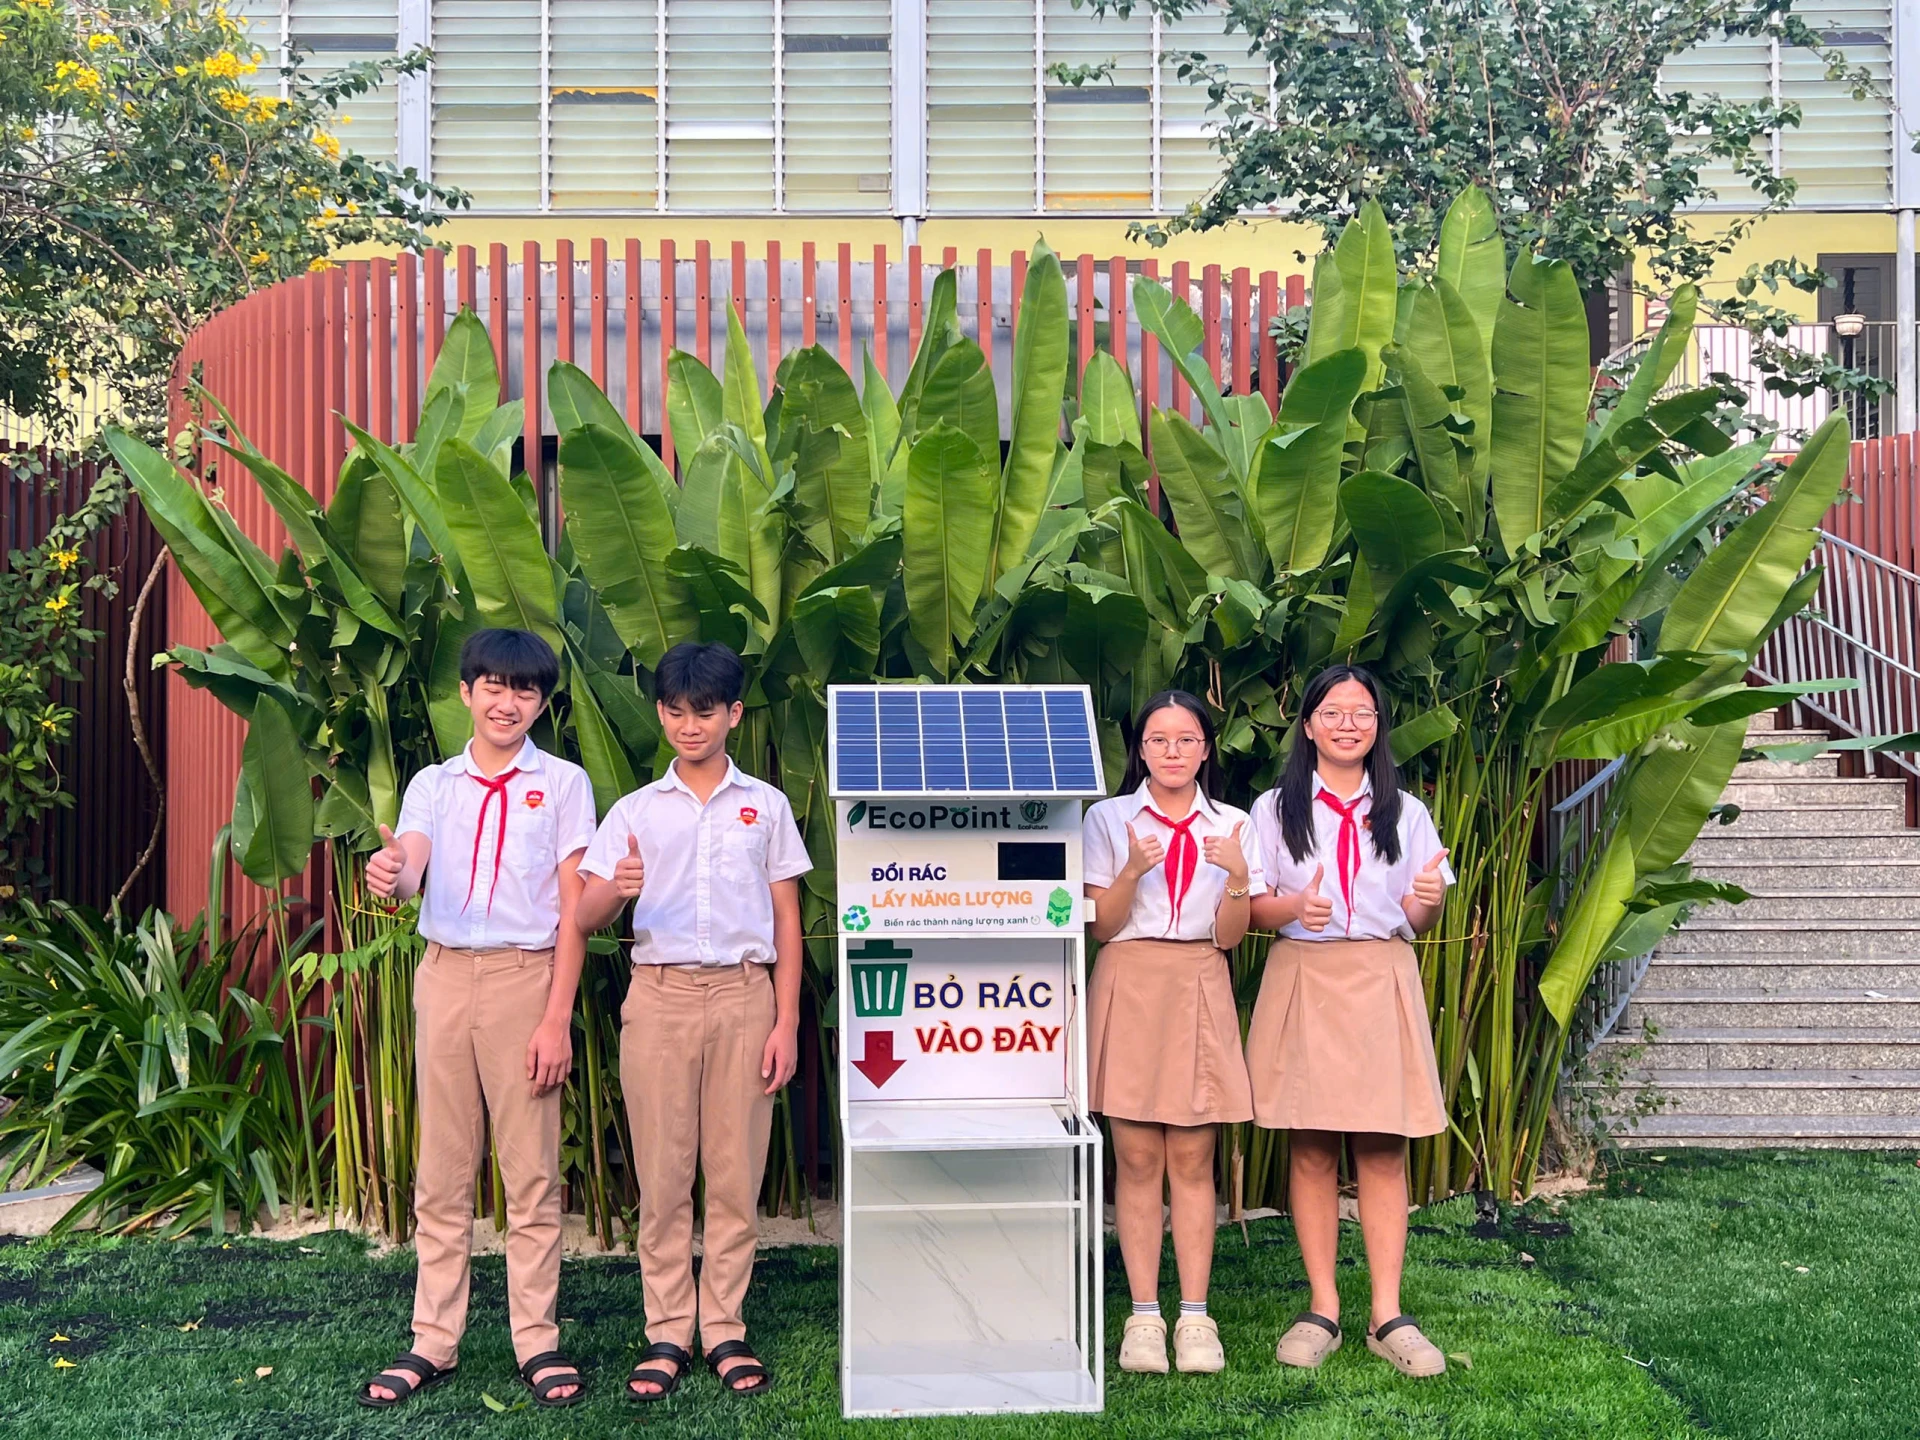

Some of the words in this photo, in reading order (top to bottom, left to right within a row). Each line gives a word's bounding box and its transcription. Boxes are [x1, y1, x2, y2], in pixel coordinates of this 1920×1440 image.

[868, 805, 1011, 829] EcoPoint
[871, 862, 904, 881] ĐỔI
[909, 864, 947, 881] RÁC
[872, 889, 906, 908] LẤY
[911, 889, 960, 908] NĂNG
[965, 890, 1033, 908] LƯỢNG
[884, 918, 904, 927] Biến
[906, 917, 921, 926] rác
[923, 917, 949, 926] thành
[951, 917, 973, 927] năng
[975, 917, 1004, 927] lượng
[1006, 916, 1028, 925] xanh
[914, 975, 964, 1009] BỎ
[978, 975, 1053, 1009] RÁC
[914, 1020, 983, 1053] VÀO
[992, 1019, 1062, 1053] ĐÂY
